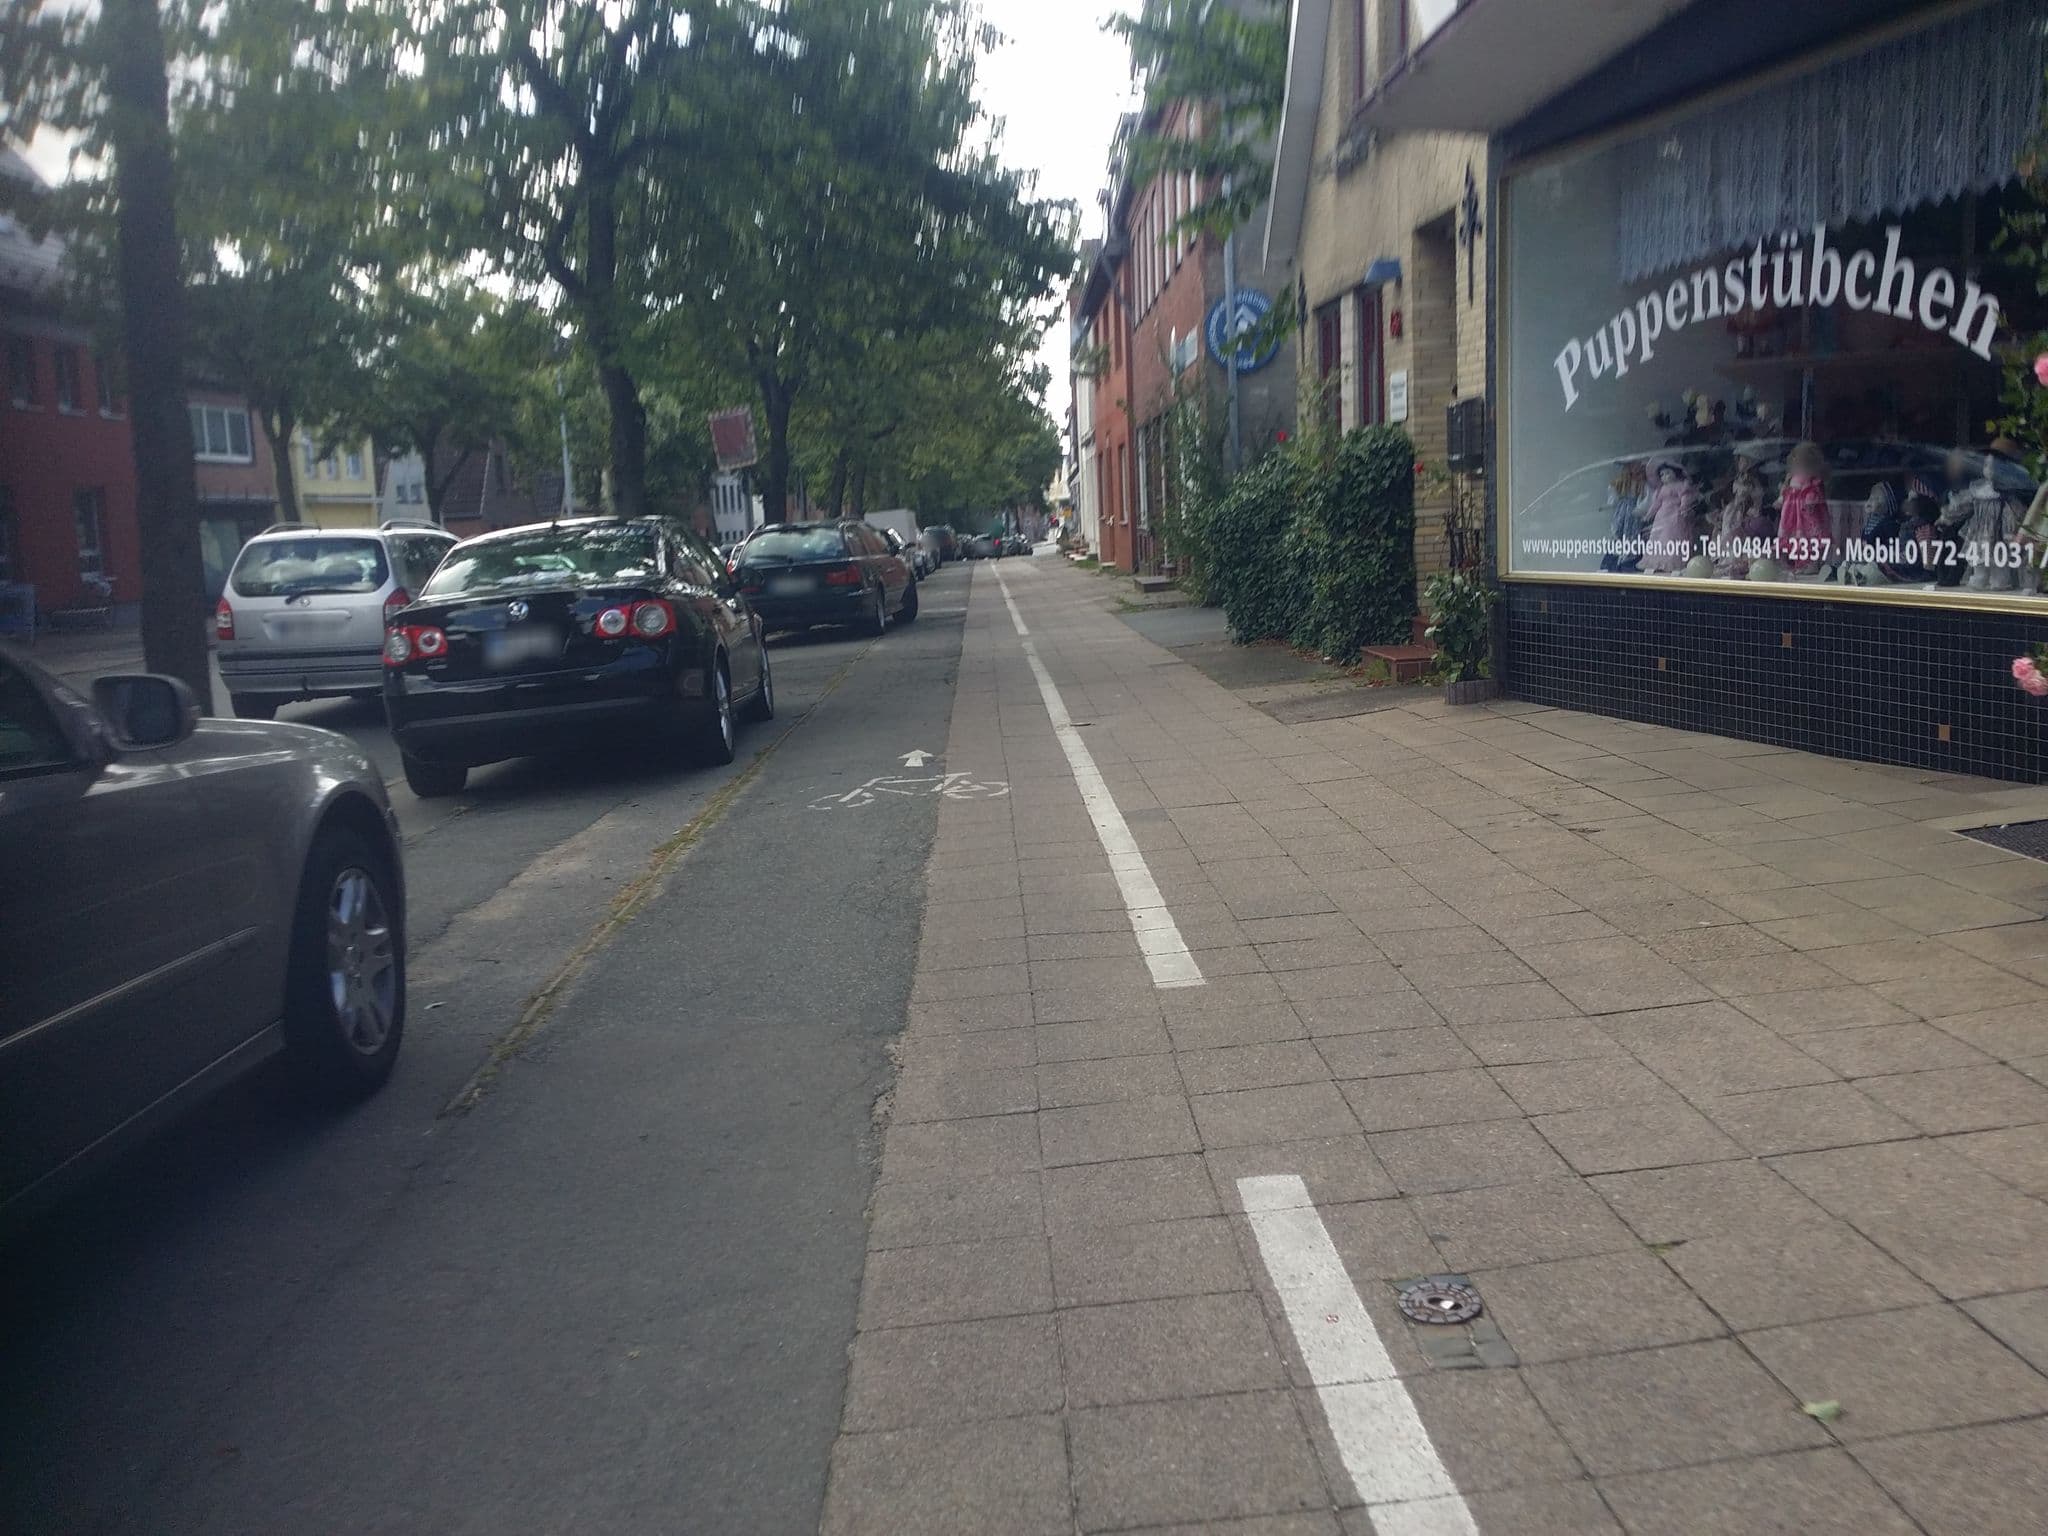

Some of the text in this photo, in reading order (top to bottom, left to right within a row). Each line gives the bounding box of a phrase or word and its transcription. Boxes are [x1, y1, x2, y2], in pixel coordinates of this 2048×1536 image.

[1553, 222, 2000, 412] Puppenstübchen
[1522, 534, 1690, 562] www.puppenstuebchen.org
[1699, 534, 1730, 558] Tel.:
[1732, 536, 1831, 561] 04841-2337
[1845, 537, 1900, 564] Mobil
